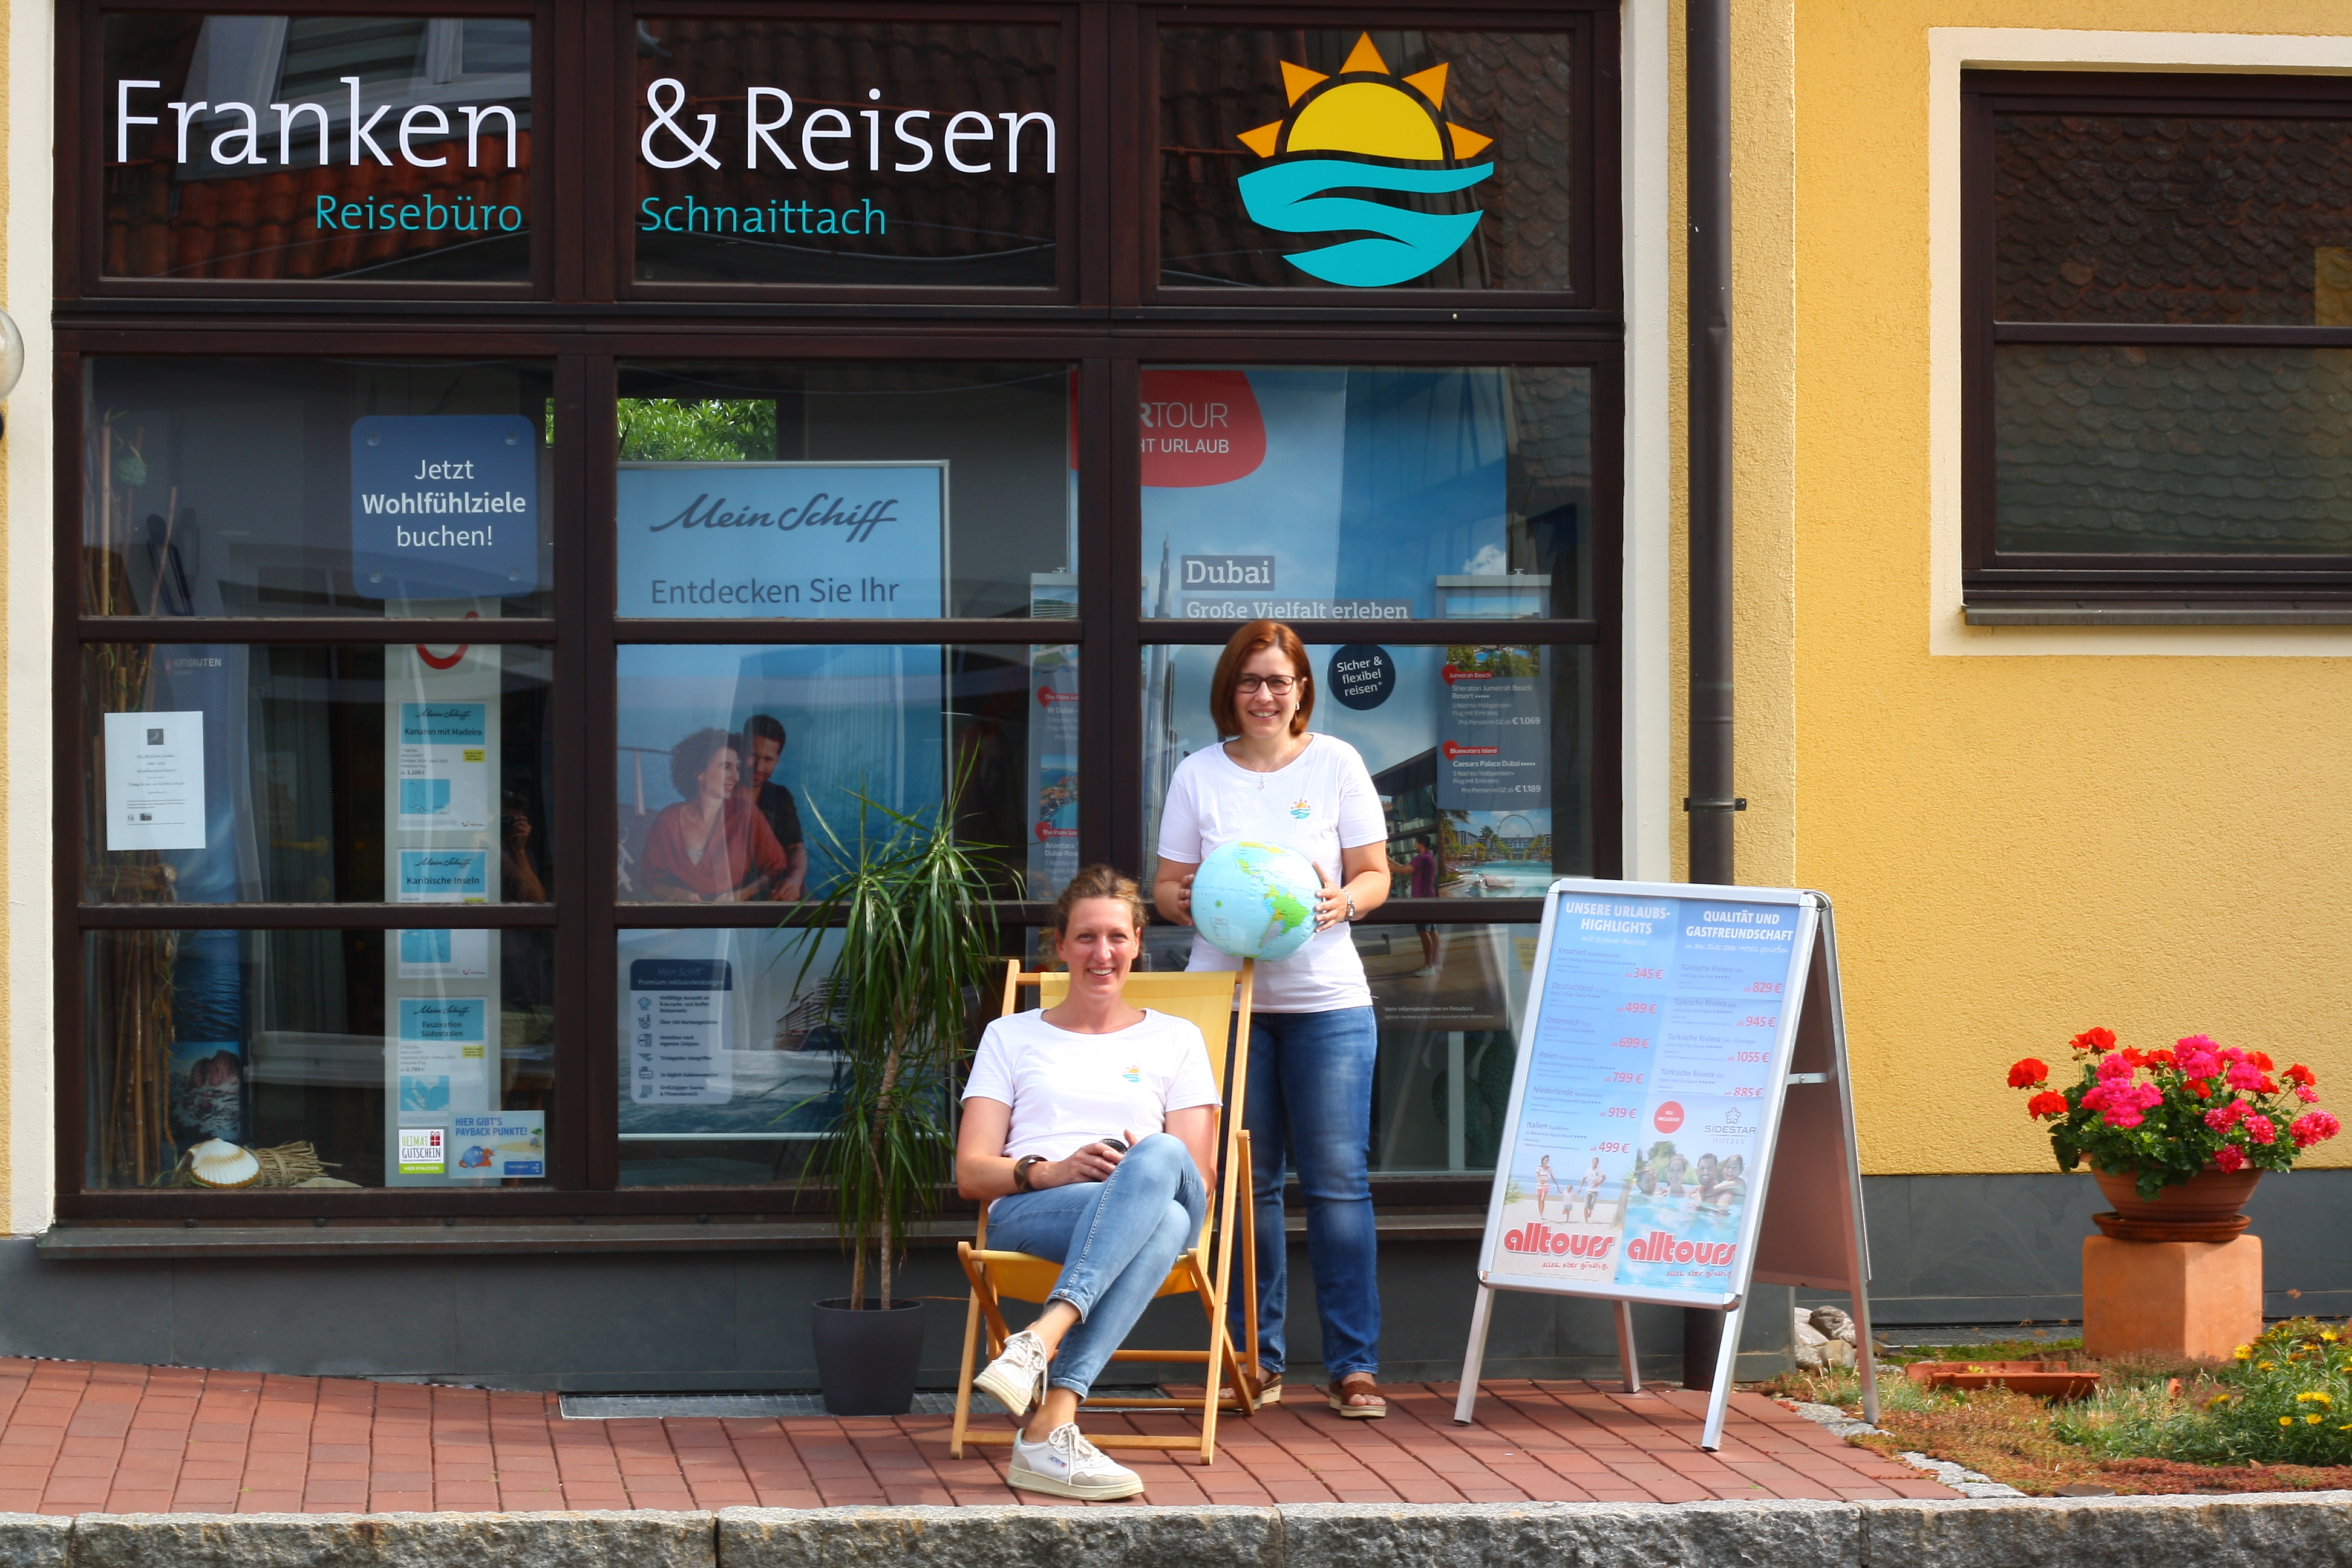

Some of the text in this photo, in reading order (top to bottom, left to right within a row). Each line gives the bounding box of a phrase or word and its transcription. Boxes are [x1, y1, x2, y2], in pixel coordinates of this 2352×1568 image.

[117, 76, 1056, 174] Franken & Reisen
[315, 194, 886, 235] Reisebüro Schnaittach
[1161, 439, 1229, 454] URLAUB
[414, 459, 474, 480] Jetzt
[362, 491, 526, 514] Wohlfühlziele
[650, 492, 899, 543] Mein Schiff
[397, 524, 493, 547] buchen!
[1186, 560, 1270, 584] Dubai
[652, 577, 899, 604] Entdecken Sie Ihr
[1186, 601, 1408, 619] Große Vielfalt erleben
[1337, 656, 1383, 673] Sicher &
[1342, 668, 1382, 684] flexibel
[415, 708, 471, 720] Mein Schiff
[1519, 716, 1540, 725] 1.069
[415, 857, 471, 869] Mein Schiff
[1566, 901, 1671, 920] UNSERE URLAUBS-
[1703, 909, 1780, 924] QUALITÄT UND
[1580, 918, 1653, 935] HIGHLIGHTS
[1685, 926, 1794, 941] GASTFREUNDSCHAFT
[1595, 935, 1619, 946] eigener
[1558, 947, 1586, 956] Kroatien
[1633, 967, 1654, 979] 345
[1655, 969, 1664, 979] €
[1681, 963, 1733, 973] Türkische Riviera
[1552, 981, 1594, 992] Deutschland
[1752, 981, 1772, 993] 829
[1774, 982, 1783, 993] €
[1625, 1002, 1647, 1013] 499
[1648, 1004, 1657, 1014] €
[1674, 998, 1704, 1007] Türkische
[413, 1005, 470, 1016] Mein Schiff
[1545, 1015, 1579, 1026] Österreich
[1745, 1016, 1766, 1027] 945
[1768, 1016, 1776, 1027] €
[1619, 1036, 1639, 1048] 699
[1642, 1038, 1650, 1049] €
[1667, 1033, 1697, 1042] Türkische
[1736, 1051, 1760, 1062] 1055
[1762, 1051, 1770, 1063] €
[1613, 1071, 1633, 1083] 799
[1635, 1073, 1644, 1084] €
[1661, 1068, 1691, 1077] Türkische
[1532, 1086, 1573, 1096] Niederlande
[1733, 1086, 1754, 1097] 885
[1755, 1087, 1763, 1097] €
[1608, 1106, 1627, 1118] 919
[1628, 1108, 1637, 1119] €
[456, 1117, 474, 1126] HIER
[476, 1117, 502, 1126] GIBT'S
[1526, 1120, 1547, 1129] Italien
[456, 1127, 528, 1136] PAYBACK PUNKTE!
[402, 1135, 428, 1146] HEIMAT
[402, 1147, 440, 1158] GUTSCHEIN
[1598, 1141, 1619, 1152] 499
[1621, 1143, 1630, 1154] €
[1503, 1221, 1615, 1259] alltours
[1626, 1230, 1737, 1267] alltours
[1579, 1261, 1609, 1271] günstig.
